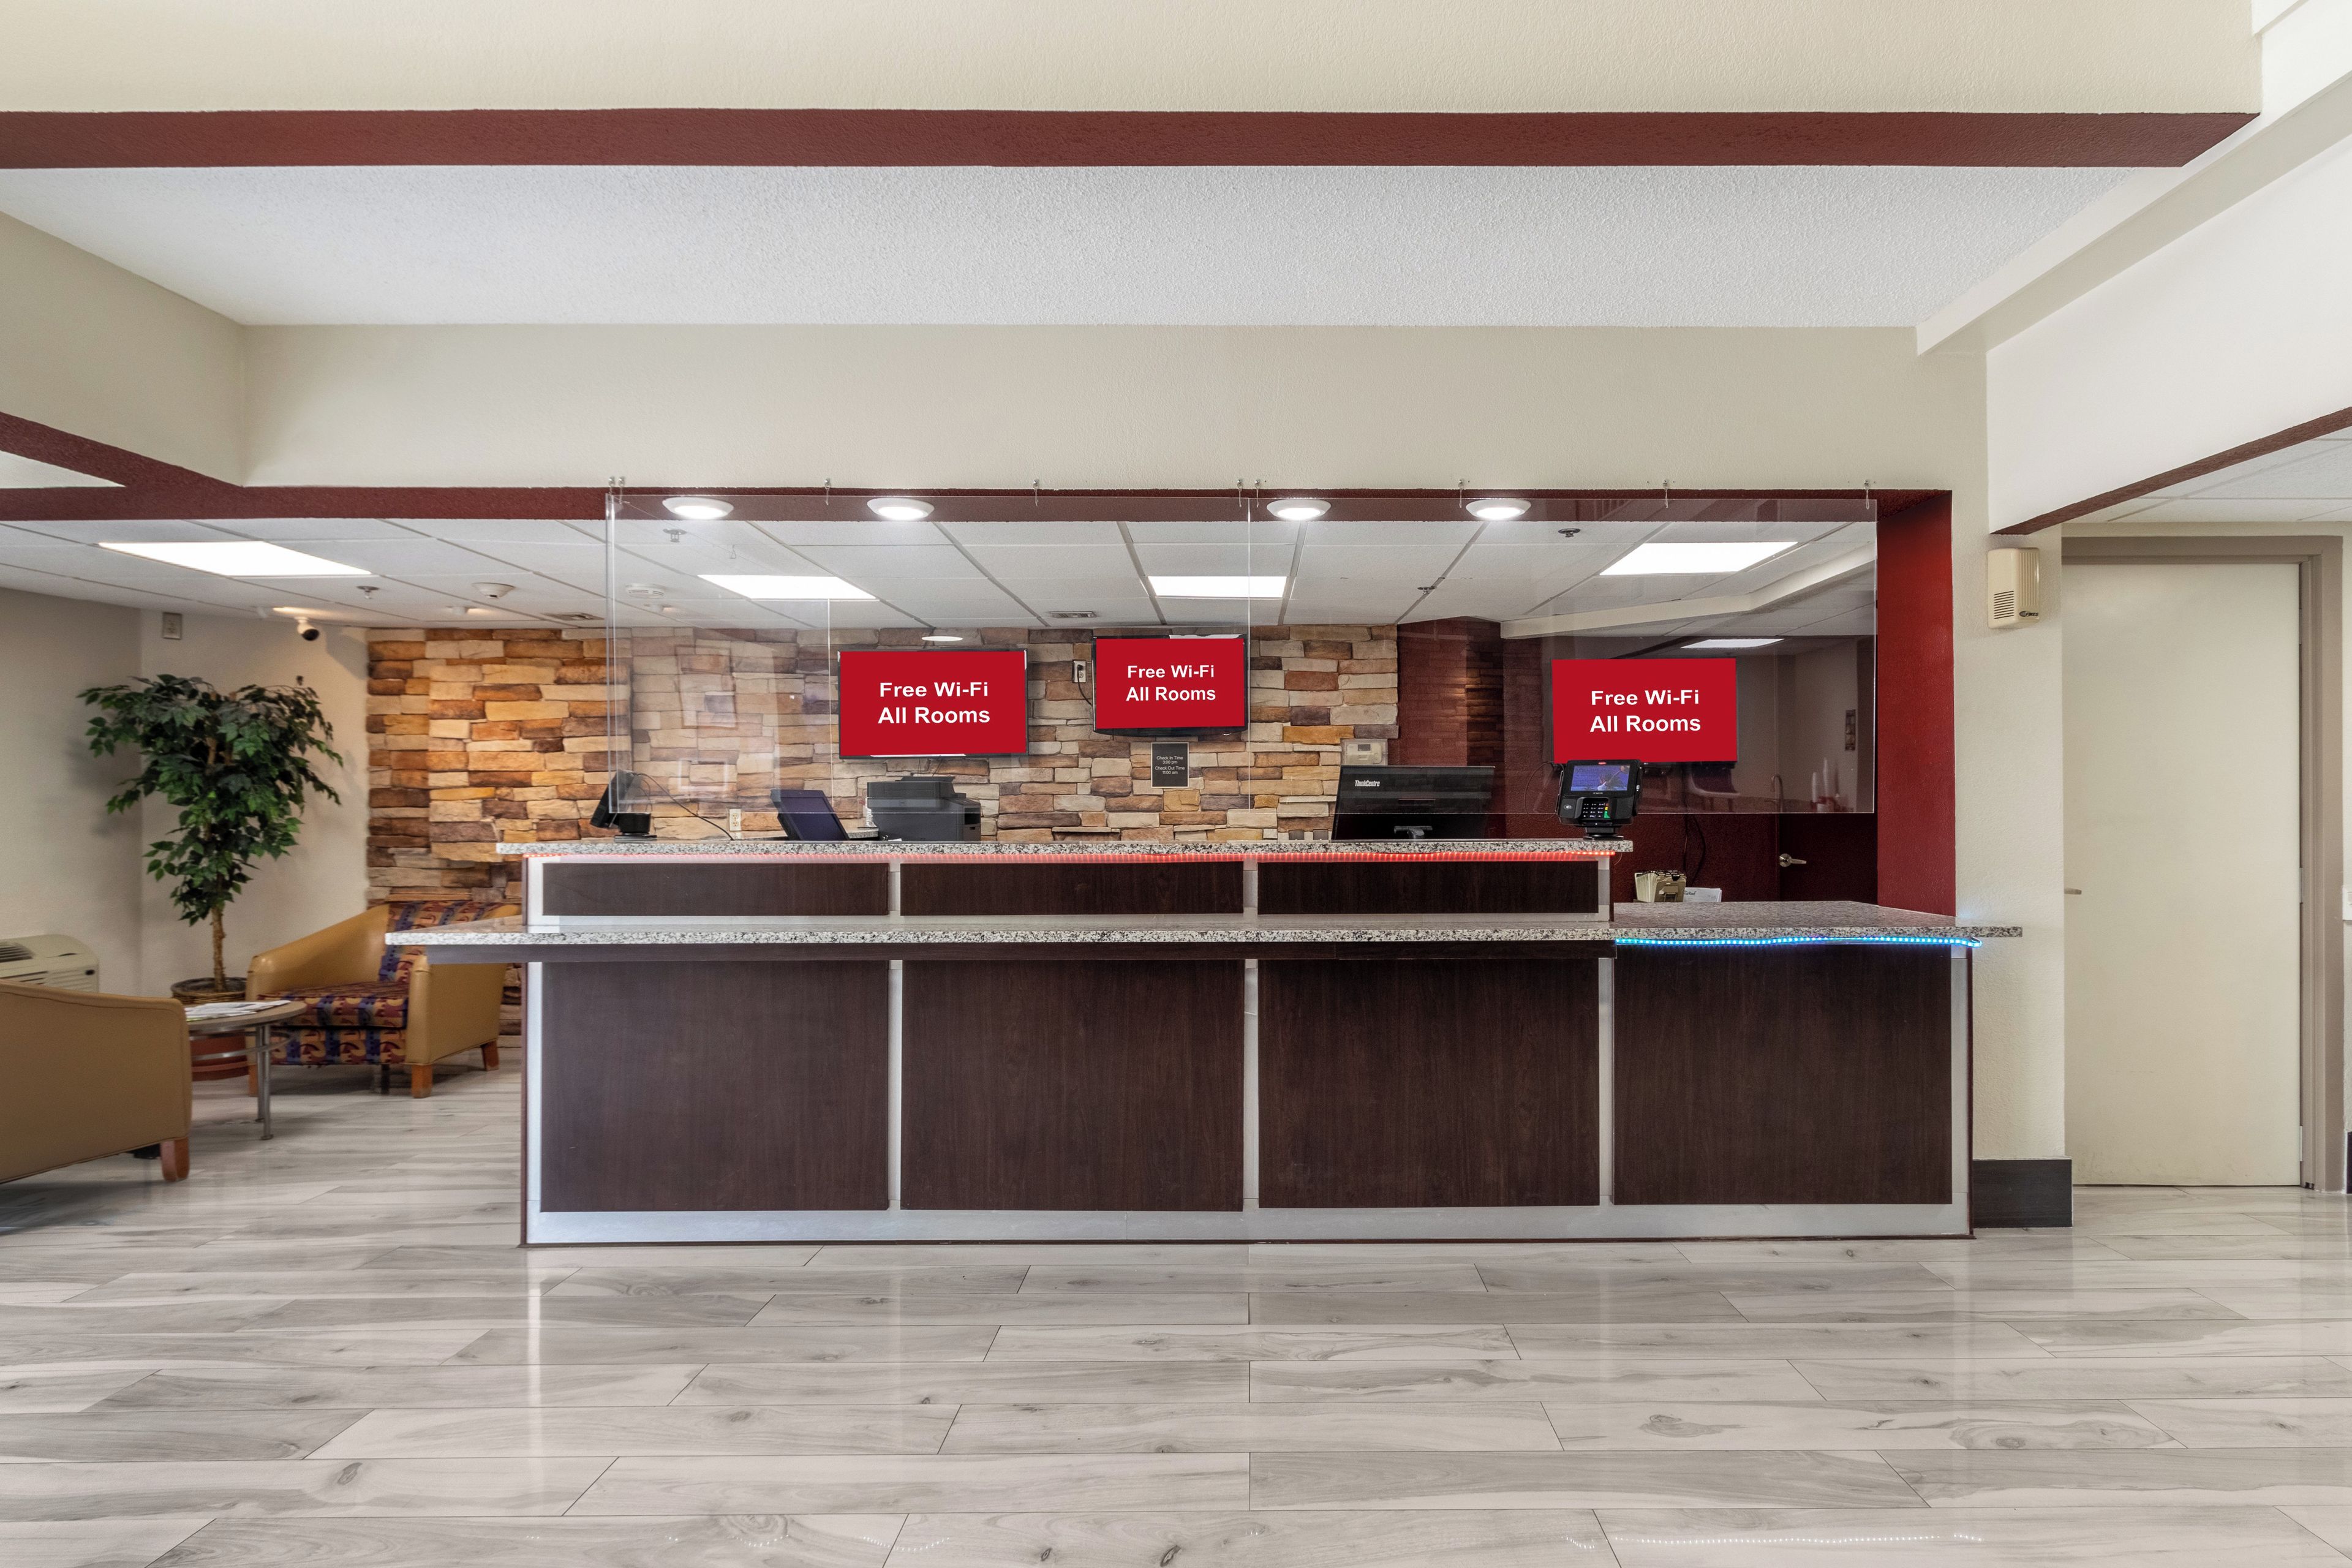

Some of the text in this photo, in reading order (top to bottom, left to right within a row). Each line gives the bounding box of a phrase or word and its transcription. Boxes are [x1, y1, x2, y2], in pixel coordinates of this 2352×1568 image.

[1128, 665, 1214, 679] Free Wi-Fi
[880, 682, 988, 698] Free Wi-Fi
[1126, 686, 1216, 701] All Rooms
[1591, 689, 1699, 706] Free Wi-Fi
[878, 706, 990, 724] All Rooms
[1589, 715, 1701, 733] All Rooms
